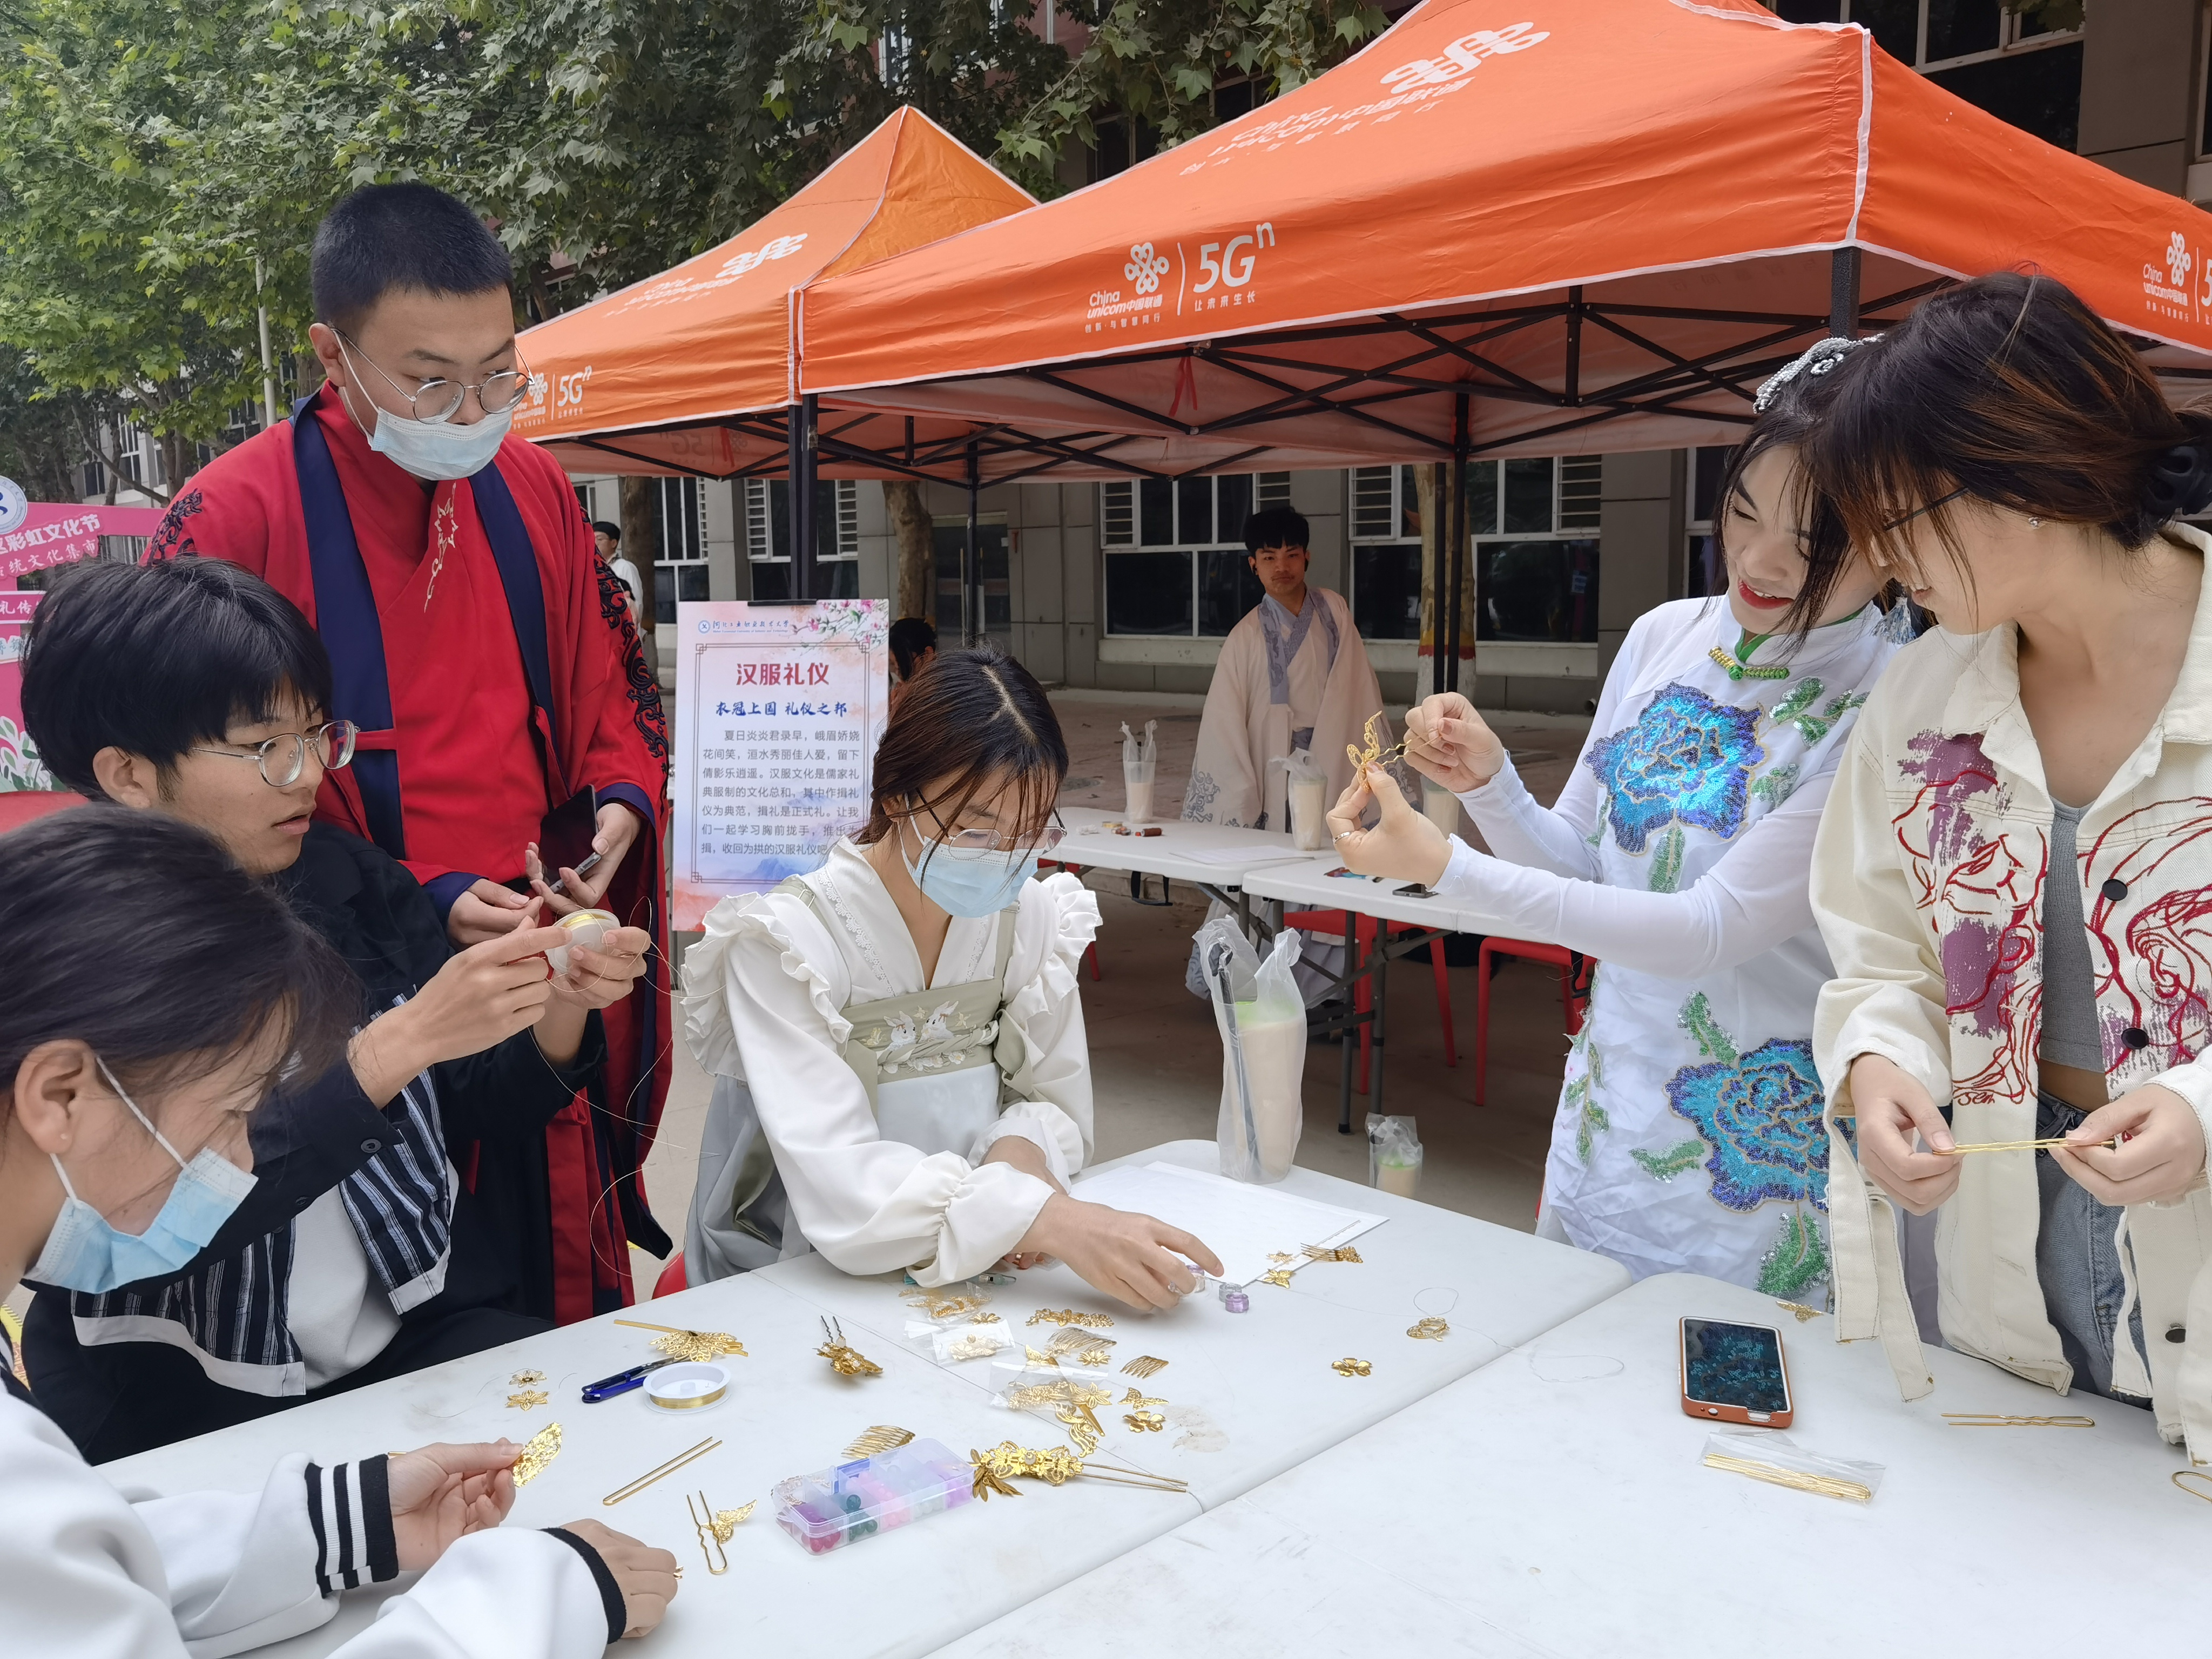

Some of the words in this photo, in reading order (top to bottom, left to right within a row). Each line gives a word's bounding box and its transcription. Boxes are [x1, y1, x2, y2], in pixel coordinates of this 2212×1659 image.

[2143, 263, 2162, 283] China
[1089, 289, 1121, 307] China
[0, 599, 39, 615] 礼传
[736, 663, 830, 686] 汉服礼仪
[716, 700, 777, 717] 衣冠上国
[784, 701, 847, 718] 礼仪之邦
